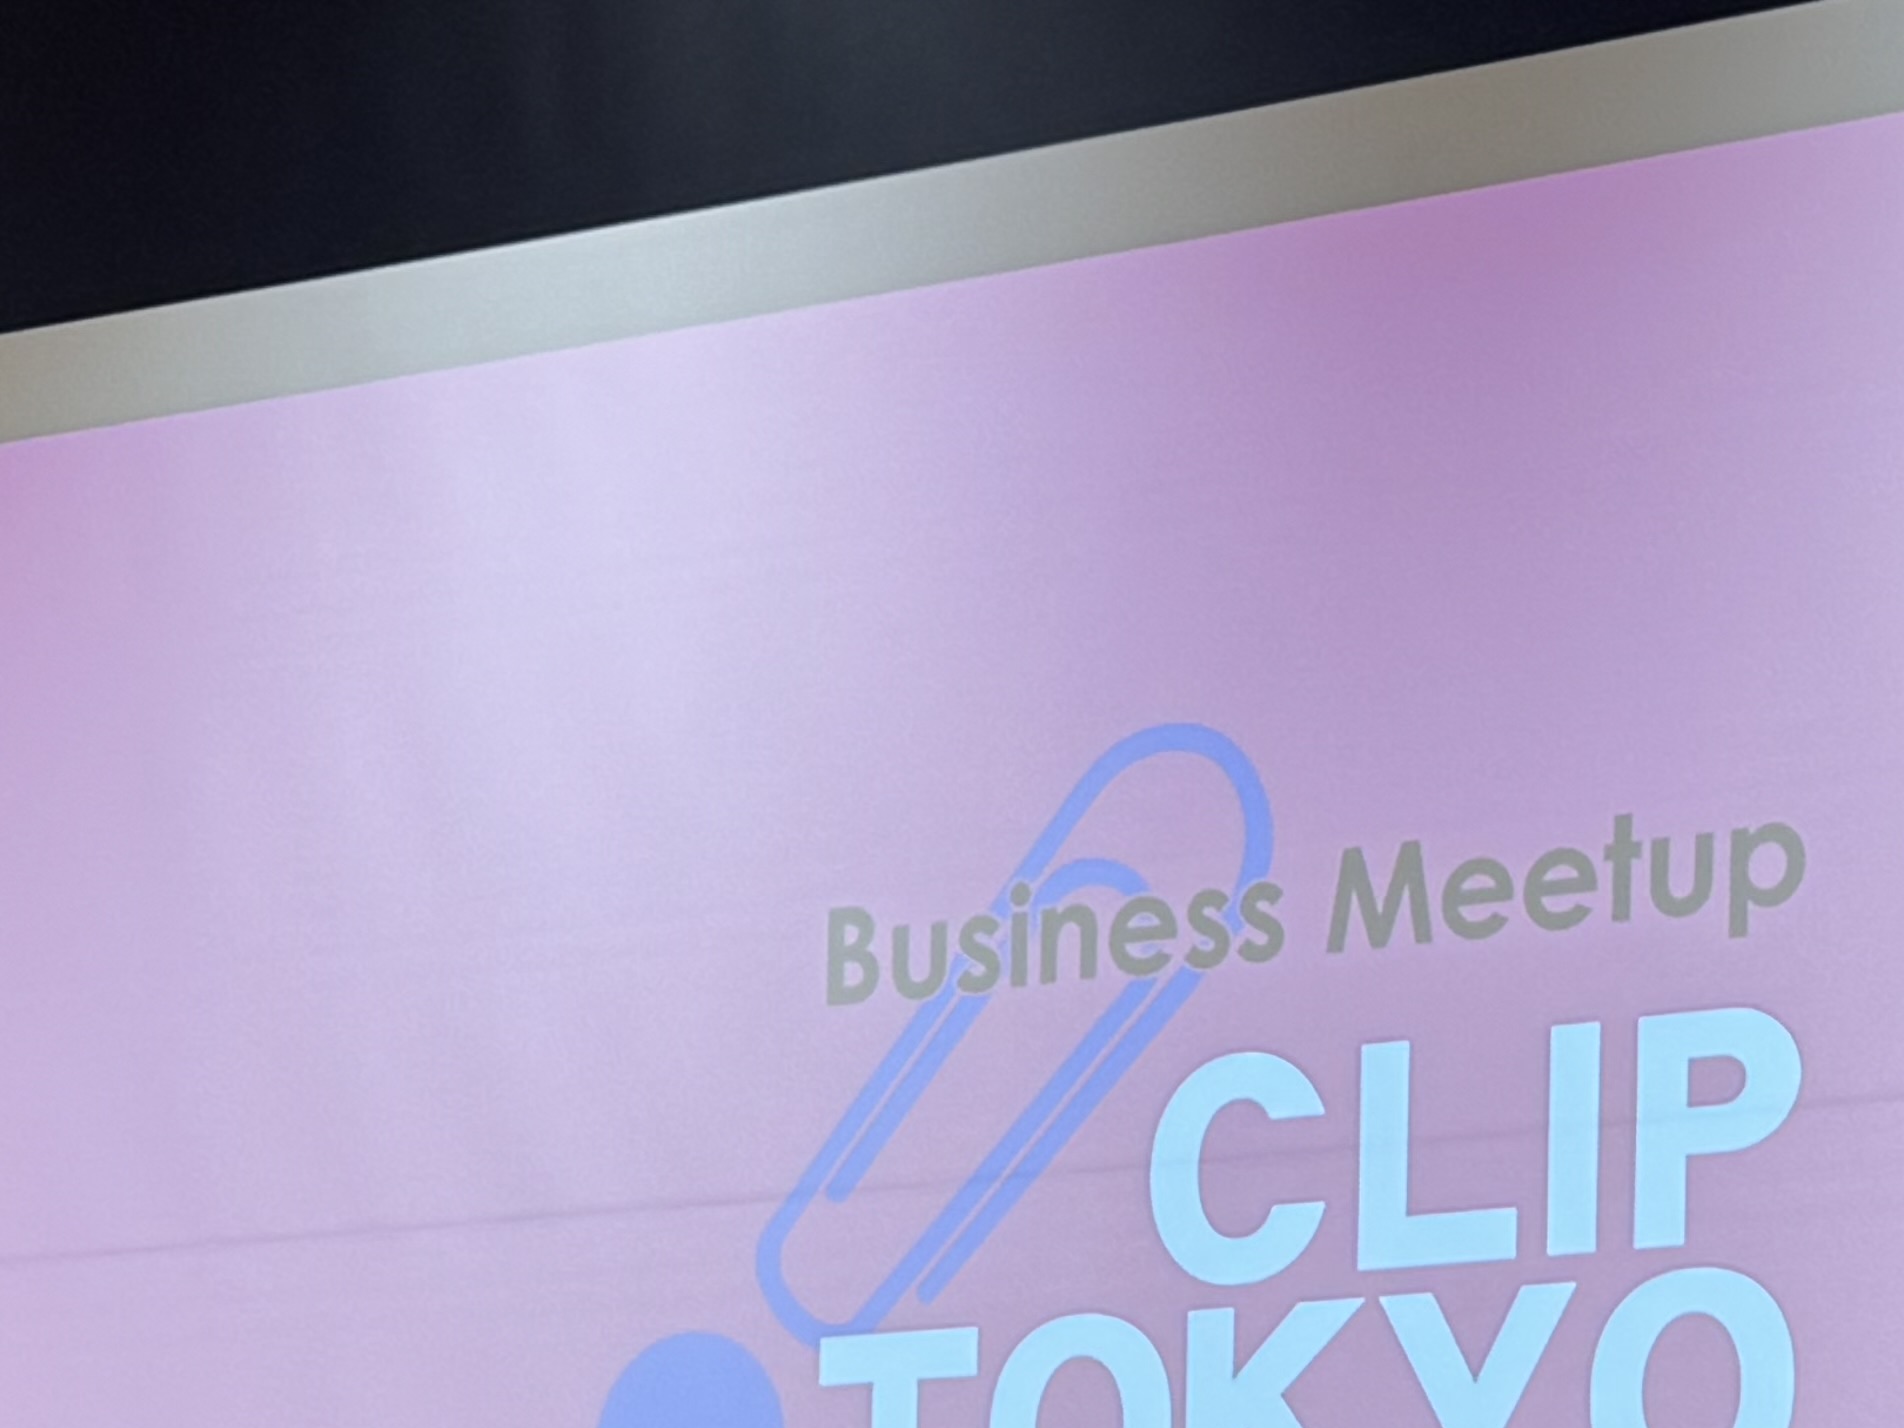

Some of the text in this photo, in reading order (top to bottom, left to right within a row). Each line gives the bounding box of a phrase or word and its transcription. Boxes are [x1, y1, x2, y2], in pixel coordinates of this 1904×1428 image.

[826, 812, 1807, 1006] Business Meetup
[1148, 1006, 1803, 1287] CLIP
